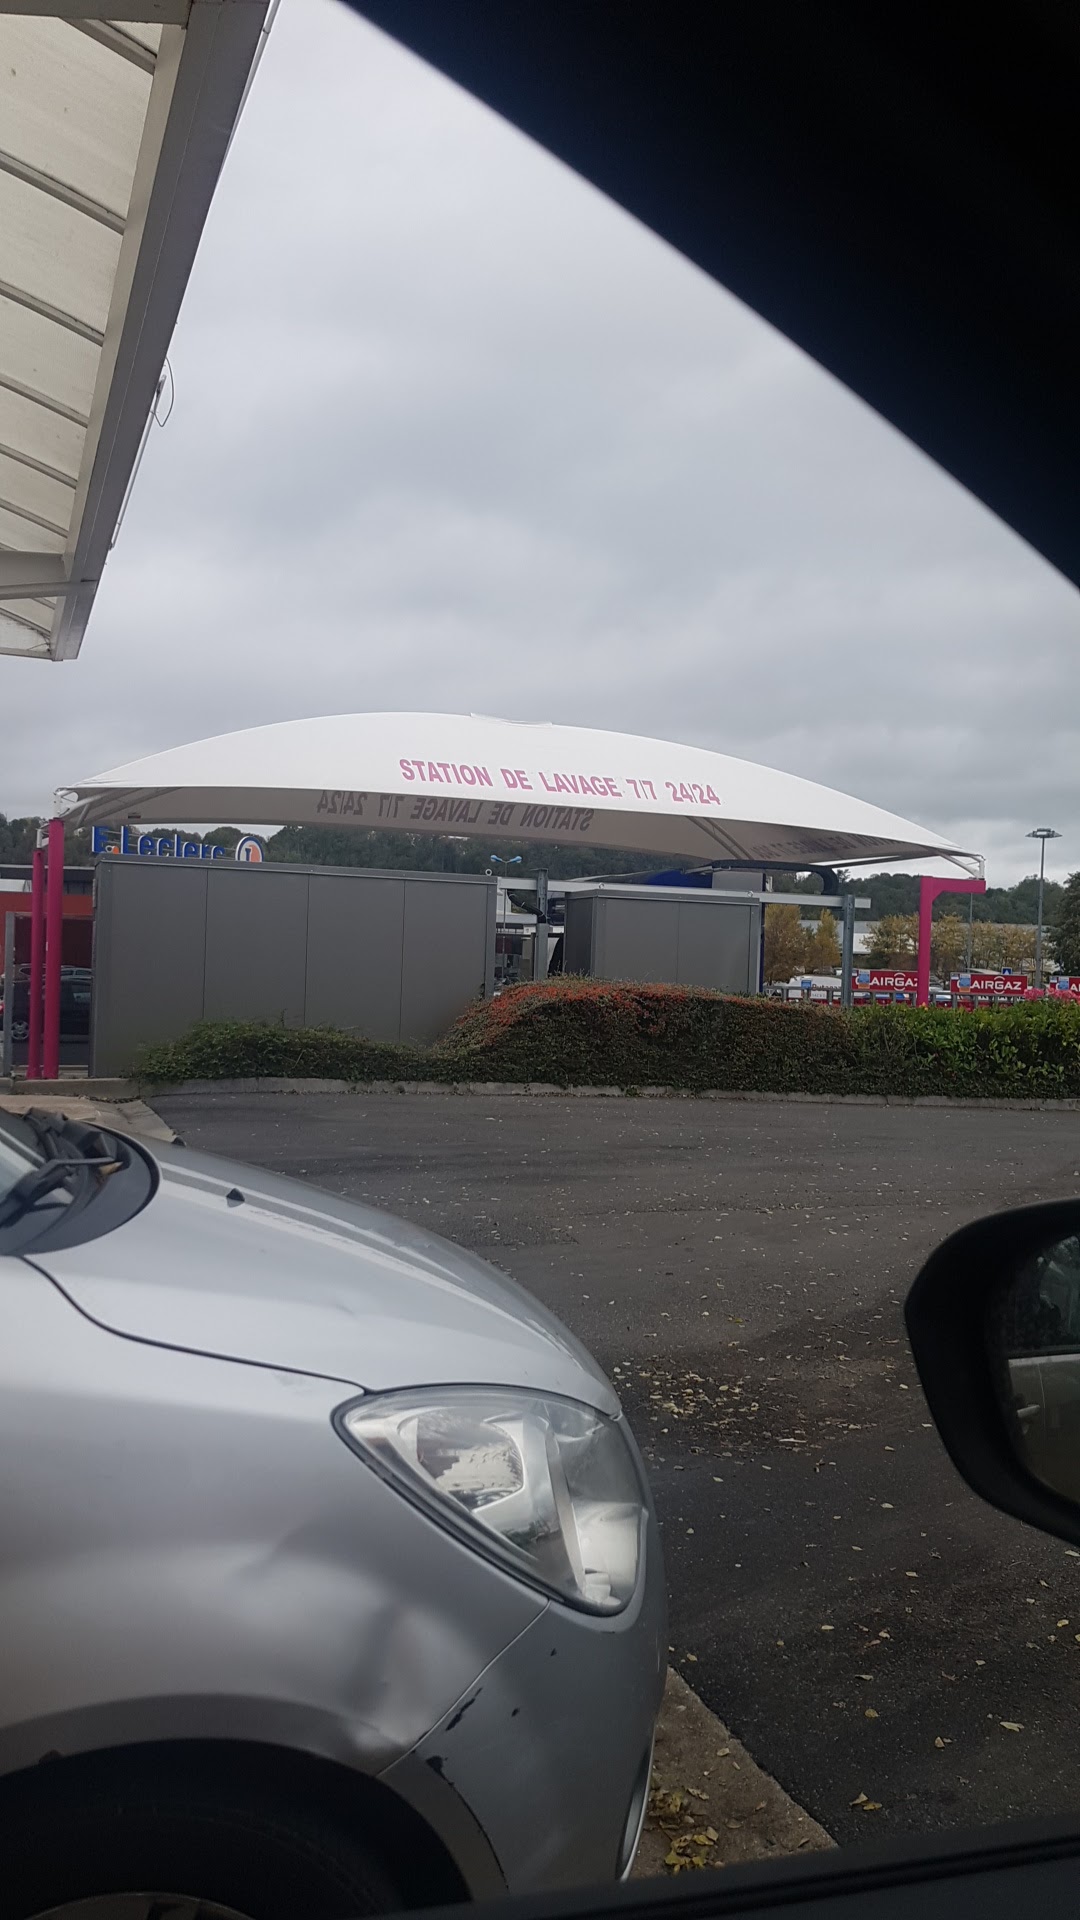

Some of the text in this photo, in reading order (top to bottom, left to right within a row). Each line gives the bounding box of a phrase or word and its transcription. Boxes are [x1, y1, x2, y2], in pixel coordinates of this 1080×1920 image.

[400, 759, 721, 806] STATION DE LAVAGE 7/7 24/24
[957, 980, 1021, 990] AIRGAZ
